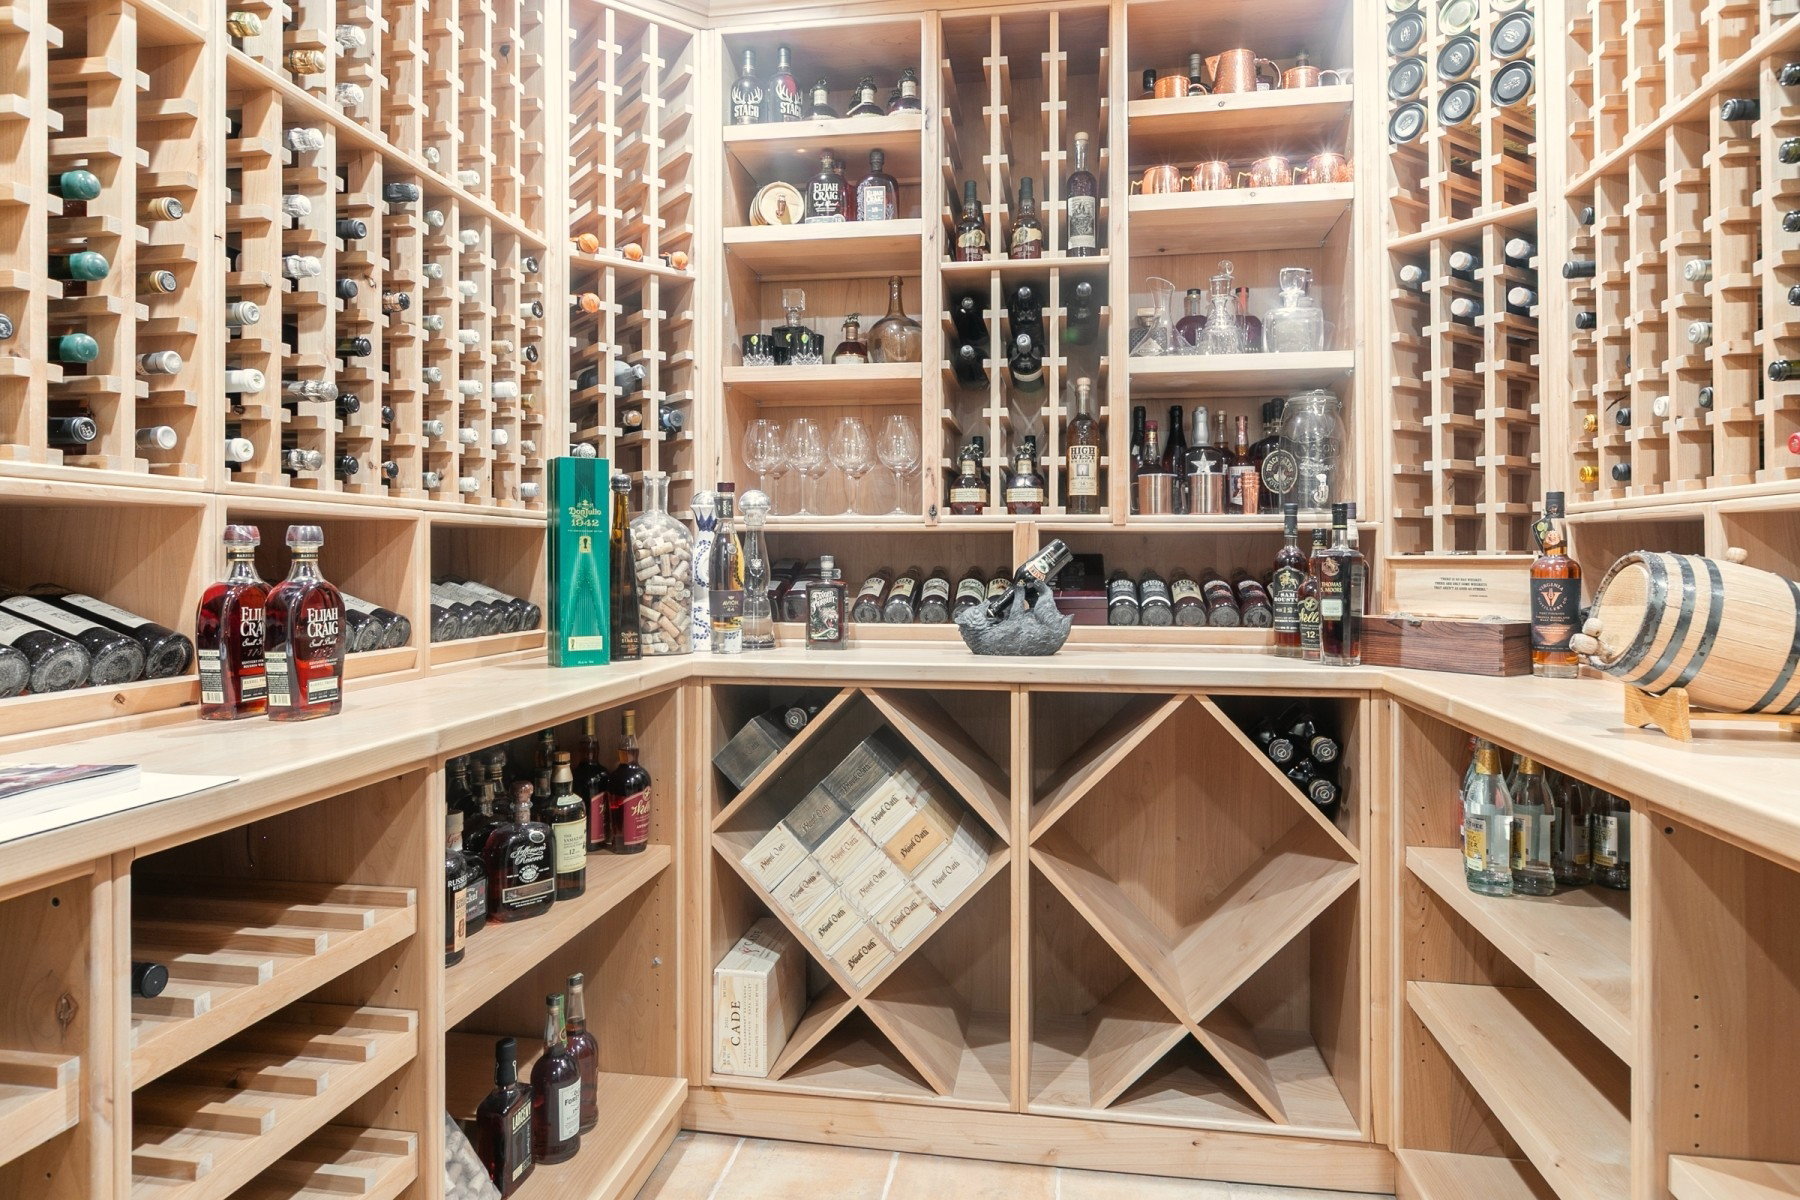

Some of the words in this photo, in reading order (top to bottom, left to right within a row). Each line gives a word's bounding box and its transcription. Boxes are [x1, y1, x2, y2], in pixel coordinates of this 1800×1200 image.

[813, 182, 838, 191] ELIJAH
[812, 191, 839, 201] CRAIG
[1070, 447, 1096, 455] HIGH
[571, 518, 600, 527] 1942
[1539, 582, 1564, 591] VIRGINIA
[241, 606, 262, 624] ELIJ
[307, 608, 338, 625] ELIJAH
[240, 622, 263, 638] CRA
[307, 621, 338, 638] CRAIG
[884, 794, 899, 811] Oath
[914, 826, 930, 843] Oath
[945, 858, 960, 874] Oath
[831, 906, 846, 922] Oath
[903, 898, 919, 916] Oath
[862, 938, 877, 955] Oath
[731, 1001, 740, 1046] CADE
